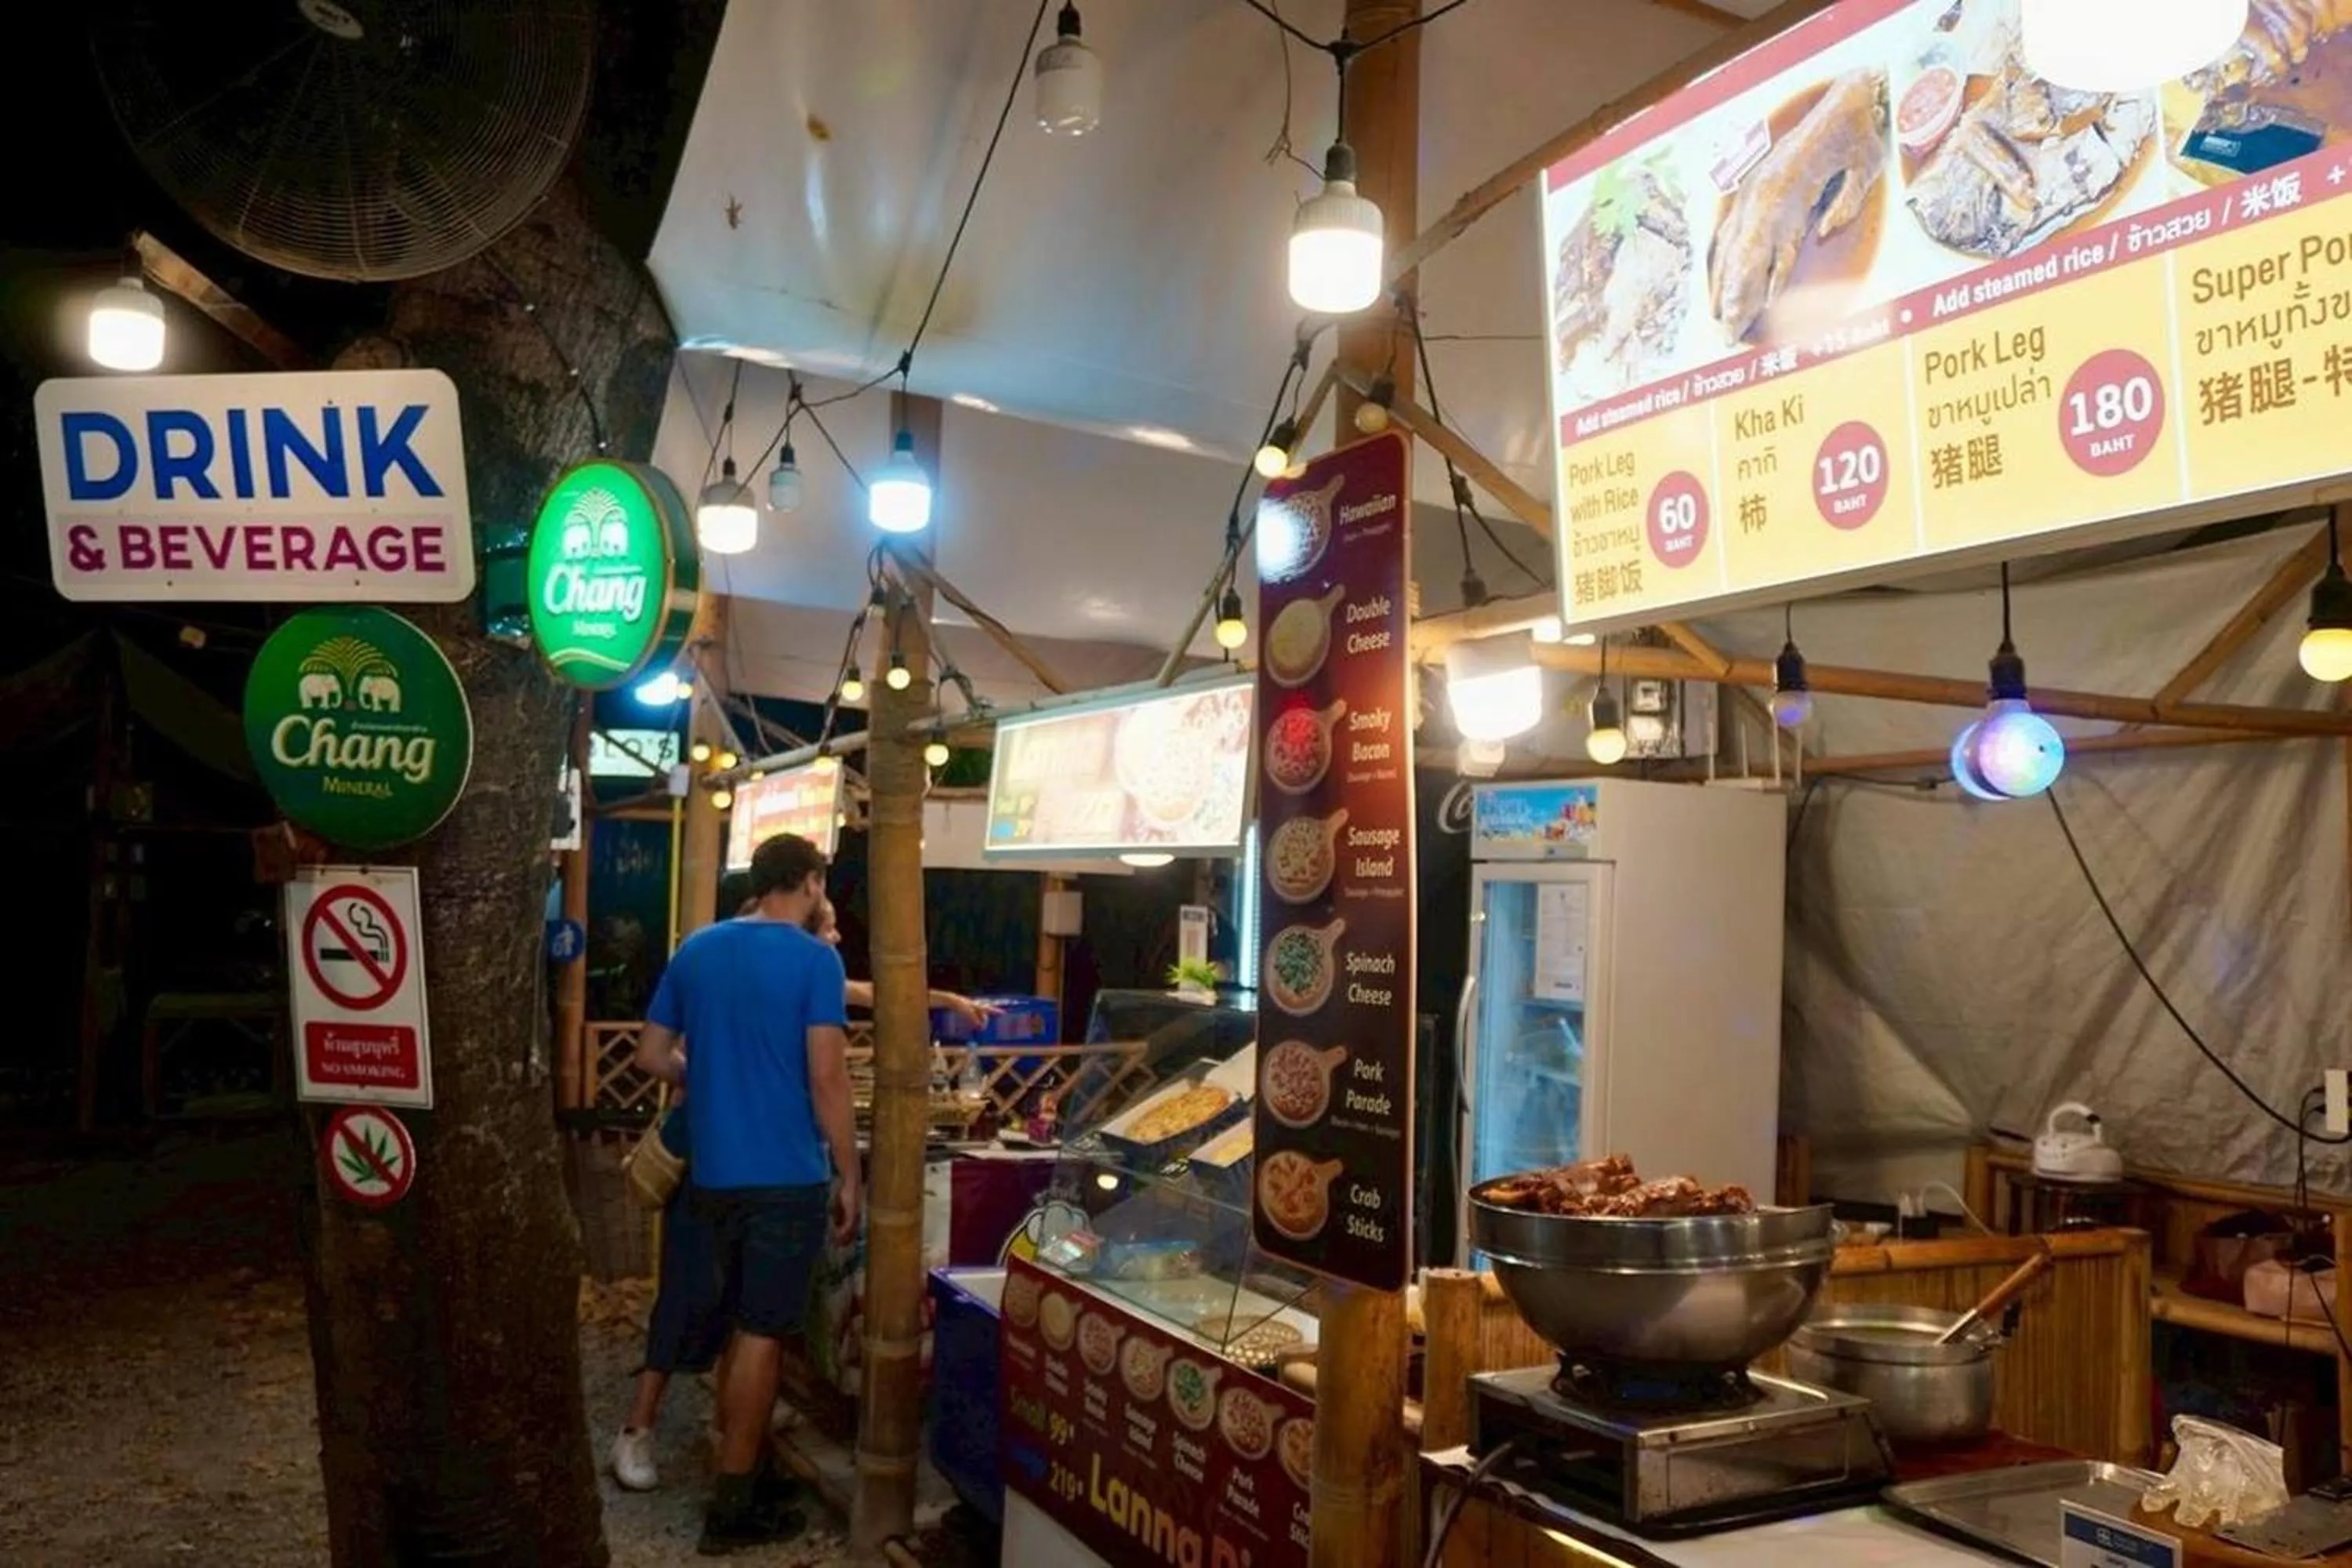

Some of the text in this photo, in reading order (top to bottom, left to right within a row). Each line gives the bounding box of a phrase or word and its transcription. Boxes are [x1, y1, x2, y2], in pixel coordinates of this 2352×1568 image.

[1933, 290, 1969, 317] Add
[1973, 252, 2058, 305] steamed
[2063, 243, 2105, 274] rice
[2127, 207, 2212, 252] ข้าวสวย
[2239, 171, 2303, 219] 米饭
[2192, 250, 2292, 304] Super
[1925, 325, 2045, 386] Pork Leg
[1928, 366, 2052, 429] ขาหมูเปล่า
[2068, 376, 2154, 437] 180
[1574, 413, 1601, 437] Add
[1734, 394, 1805, 442] Kha Ki
[60, 405, 445, 502] DRINK
[1930, 434, 2004, 490] 猪腿
[2089, 433, 2136, 458] BAHT
[1570, 452, 1635, 488] Pork Leg
[1818, 444, 1881, 495] 120
[1339, 493, 1397, 526] Hawaiian
[1570, 487, 1639, 523] with Rice
[1659, 493, 1697, 535] 60
[1833, 493, 1868, 514] BAHT
[68, 524, 447, 572] & BEVERAGE
[543, 554, 647, 622] Chang
[1345, 595, 1392, 624] Double
[1346, 630, 1391, 655] Cheese
[1348, 707, 1392, 733] Smoky
[270, 713, 437, 784] Chang
[1352, 741, 1391, 764] Bacon
[1348, 826, 1401, 851] Sausage
[1356, 855, 1395, 877] Island
[1345, 951, 1396, 978] Spinach
[1347, 982, 1393, 1007] Cheese
[1354, 1058, 1385, 1083] Pork
[1345, 1088, 1392, 1116] Parade
[1350, 1184, 1381, 1210] Crab
[1346, 1214, 1385, 1243] Sticks
[1090, 1453, 1202, 1568] Lanna
